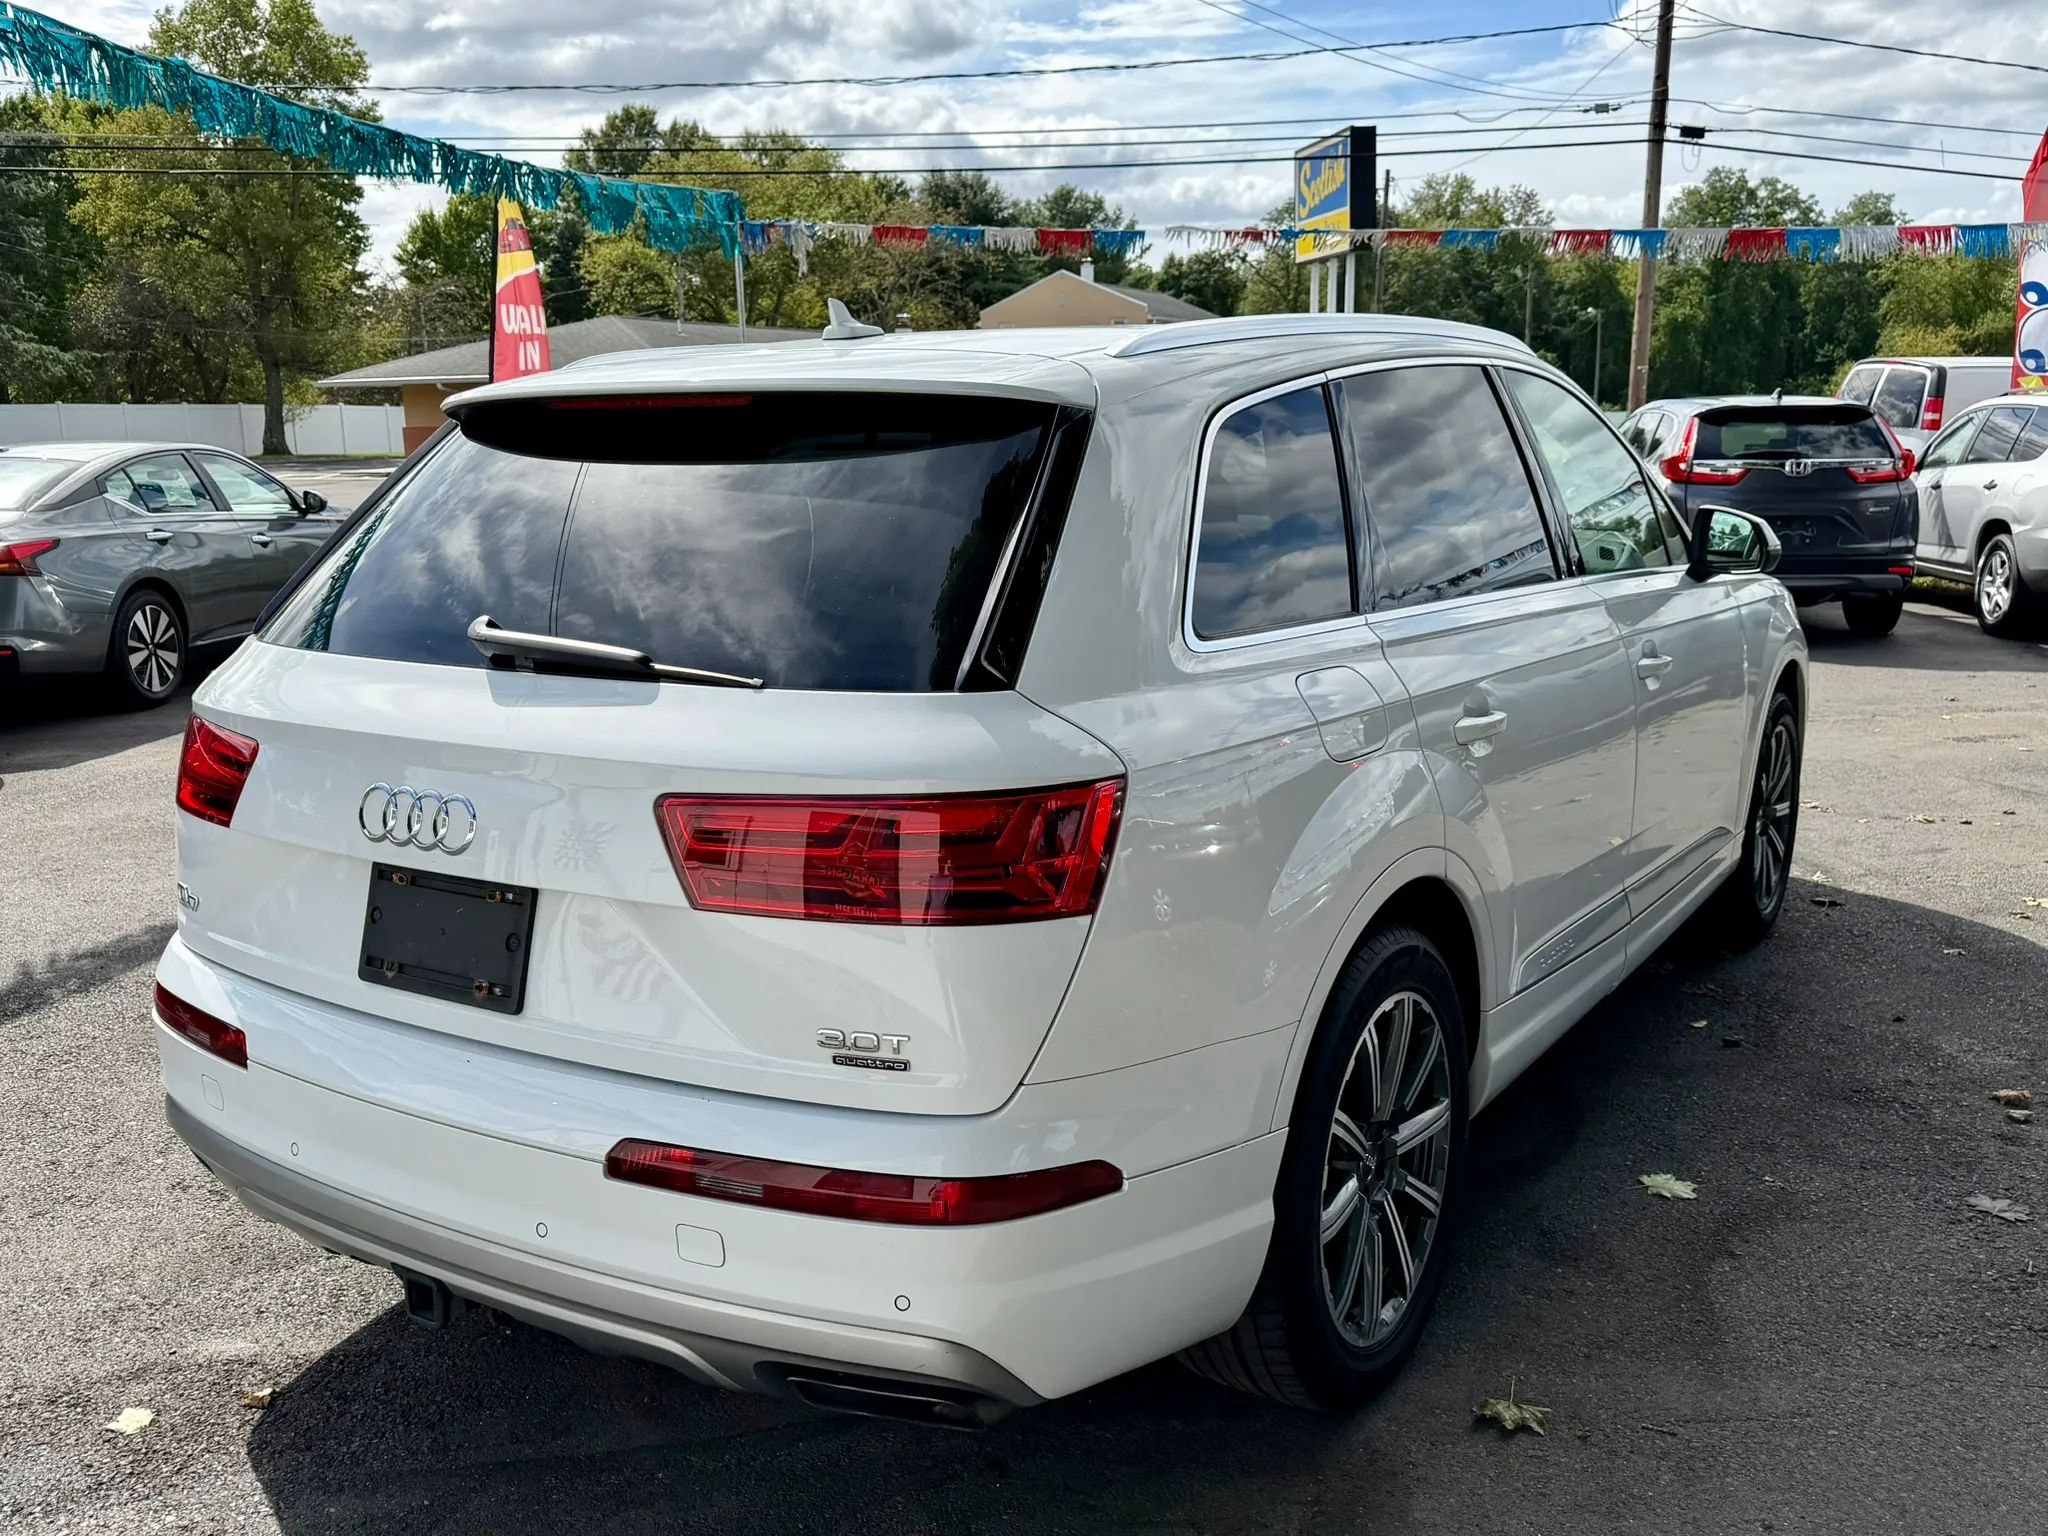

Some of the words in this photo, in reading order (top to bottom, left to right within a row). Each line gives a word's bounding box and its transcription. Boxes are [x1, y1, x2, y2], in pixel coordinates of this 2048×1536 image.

[519, 341, 540, 371] IN
[816, 1028, 910, 1055] 3.0T
[835, 1056, 906, 1070] quattro
